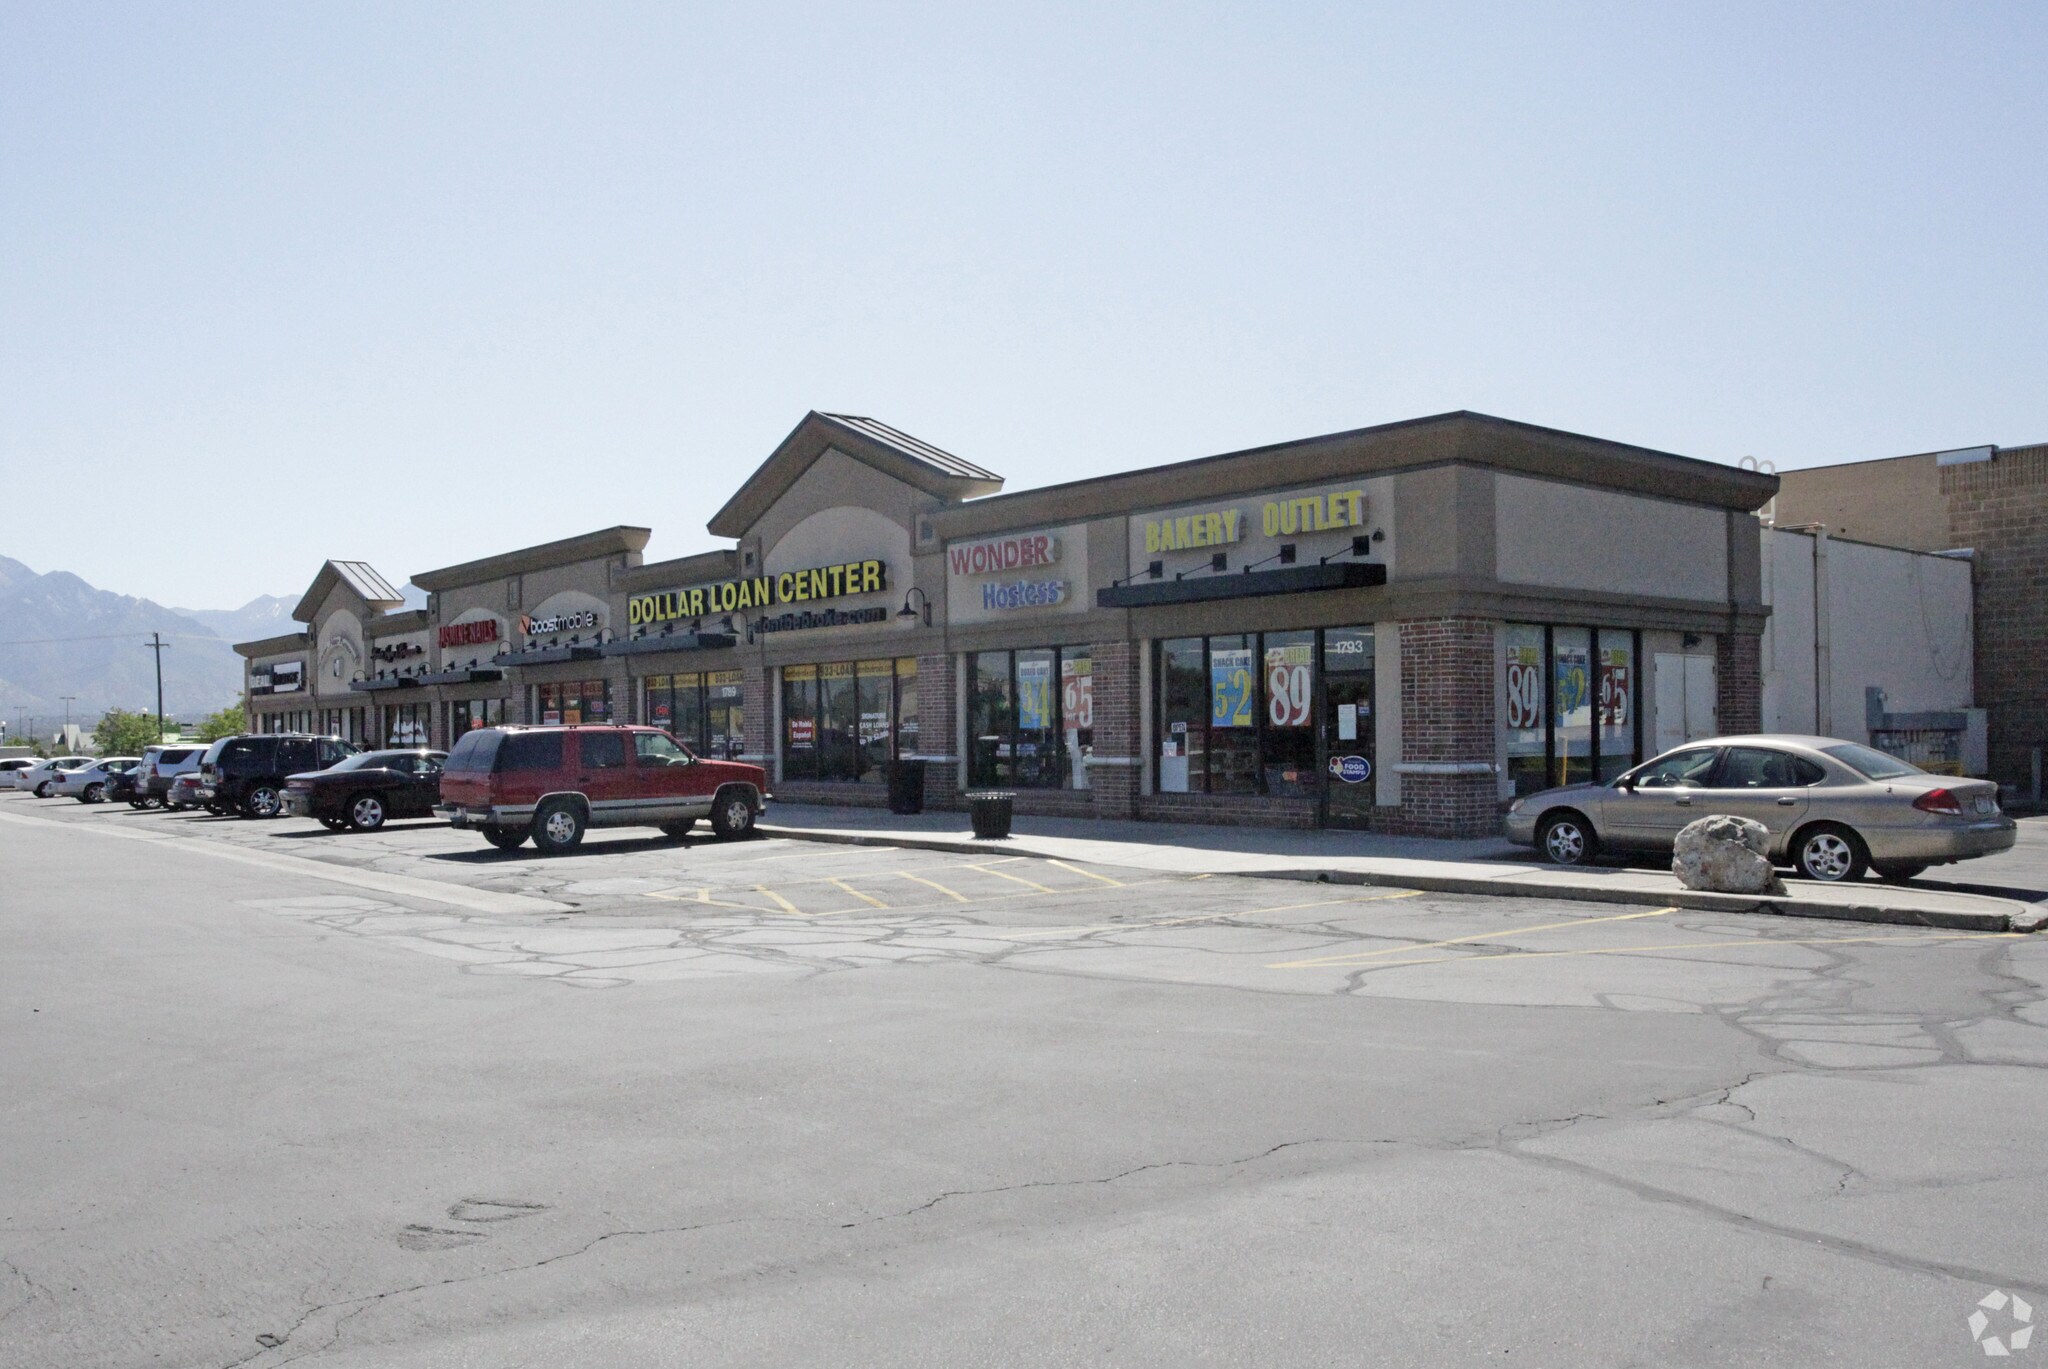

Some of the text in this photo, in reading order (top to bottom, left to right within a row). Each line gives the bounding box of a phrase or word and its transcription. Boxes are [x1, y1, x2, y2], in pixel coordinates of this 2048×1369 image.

[1145, 489, 1363, 553] BAKERY OUTLET
[950, 535, 1050, 575] WONDER
[629, 559, 881, 625] DOLLAR LOAN CENTER
[982, 579, 1061, 610] Hostess
[1335, 640, 1364, 654] 1793
[722, 687, 737, 697] 1789
[1065, 682, 1077, 710] 6
